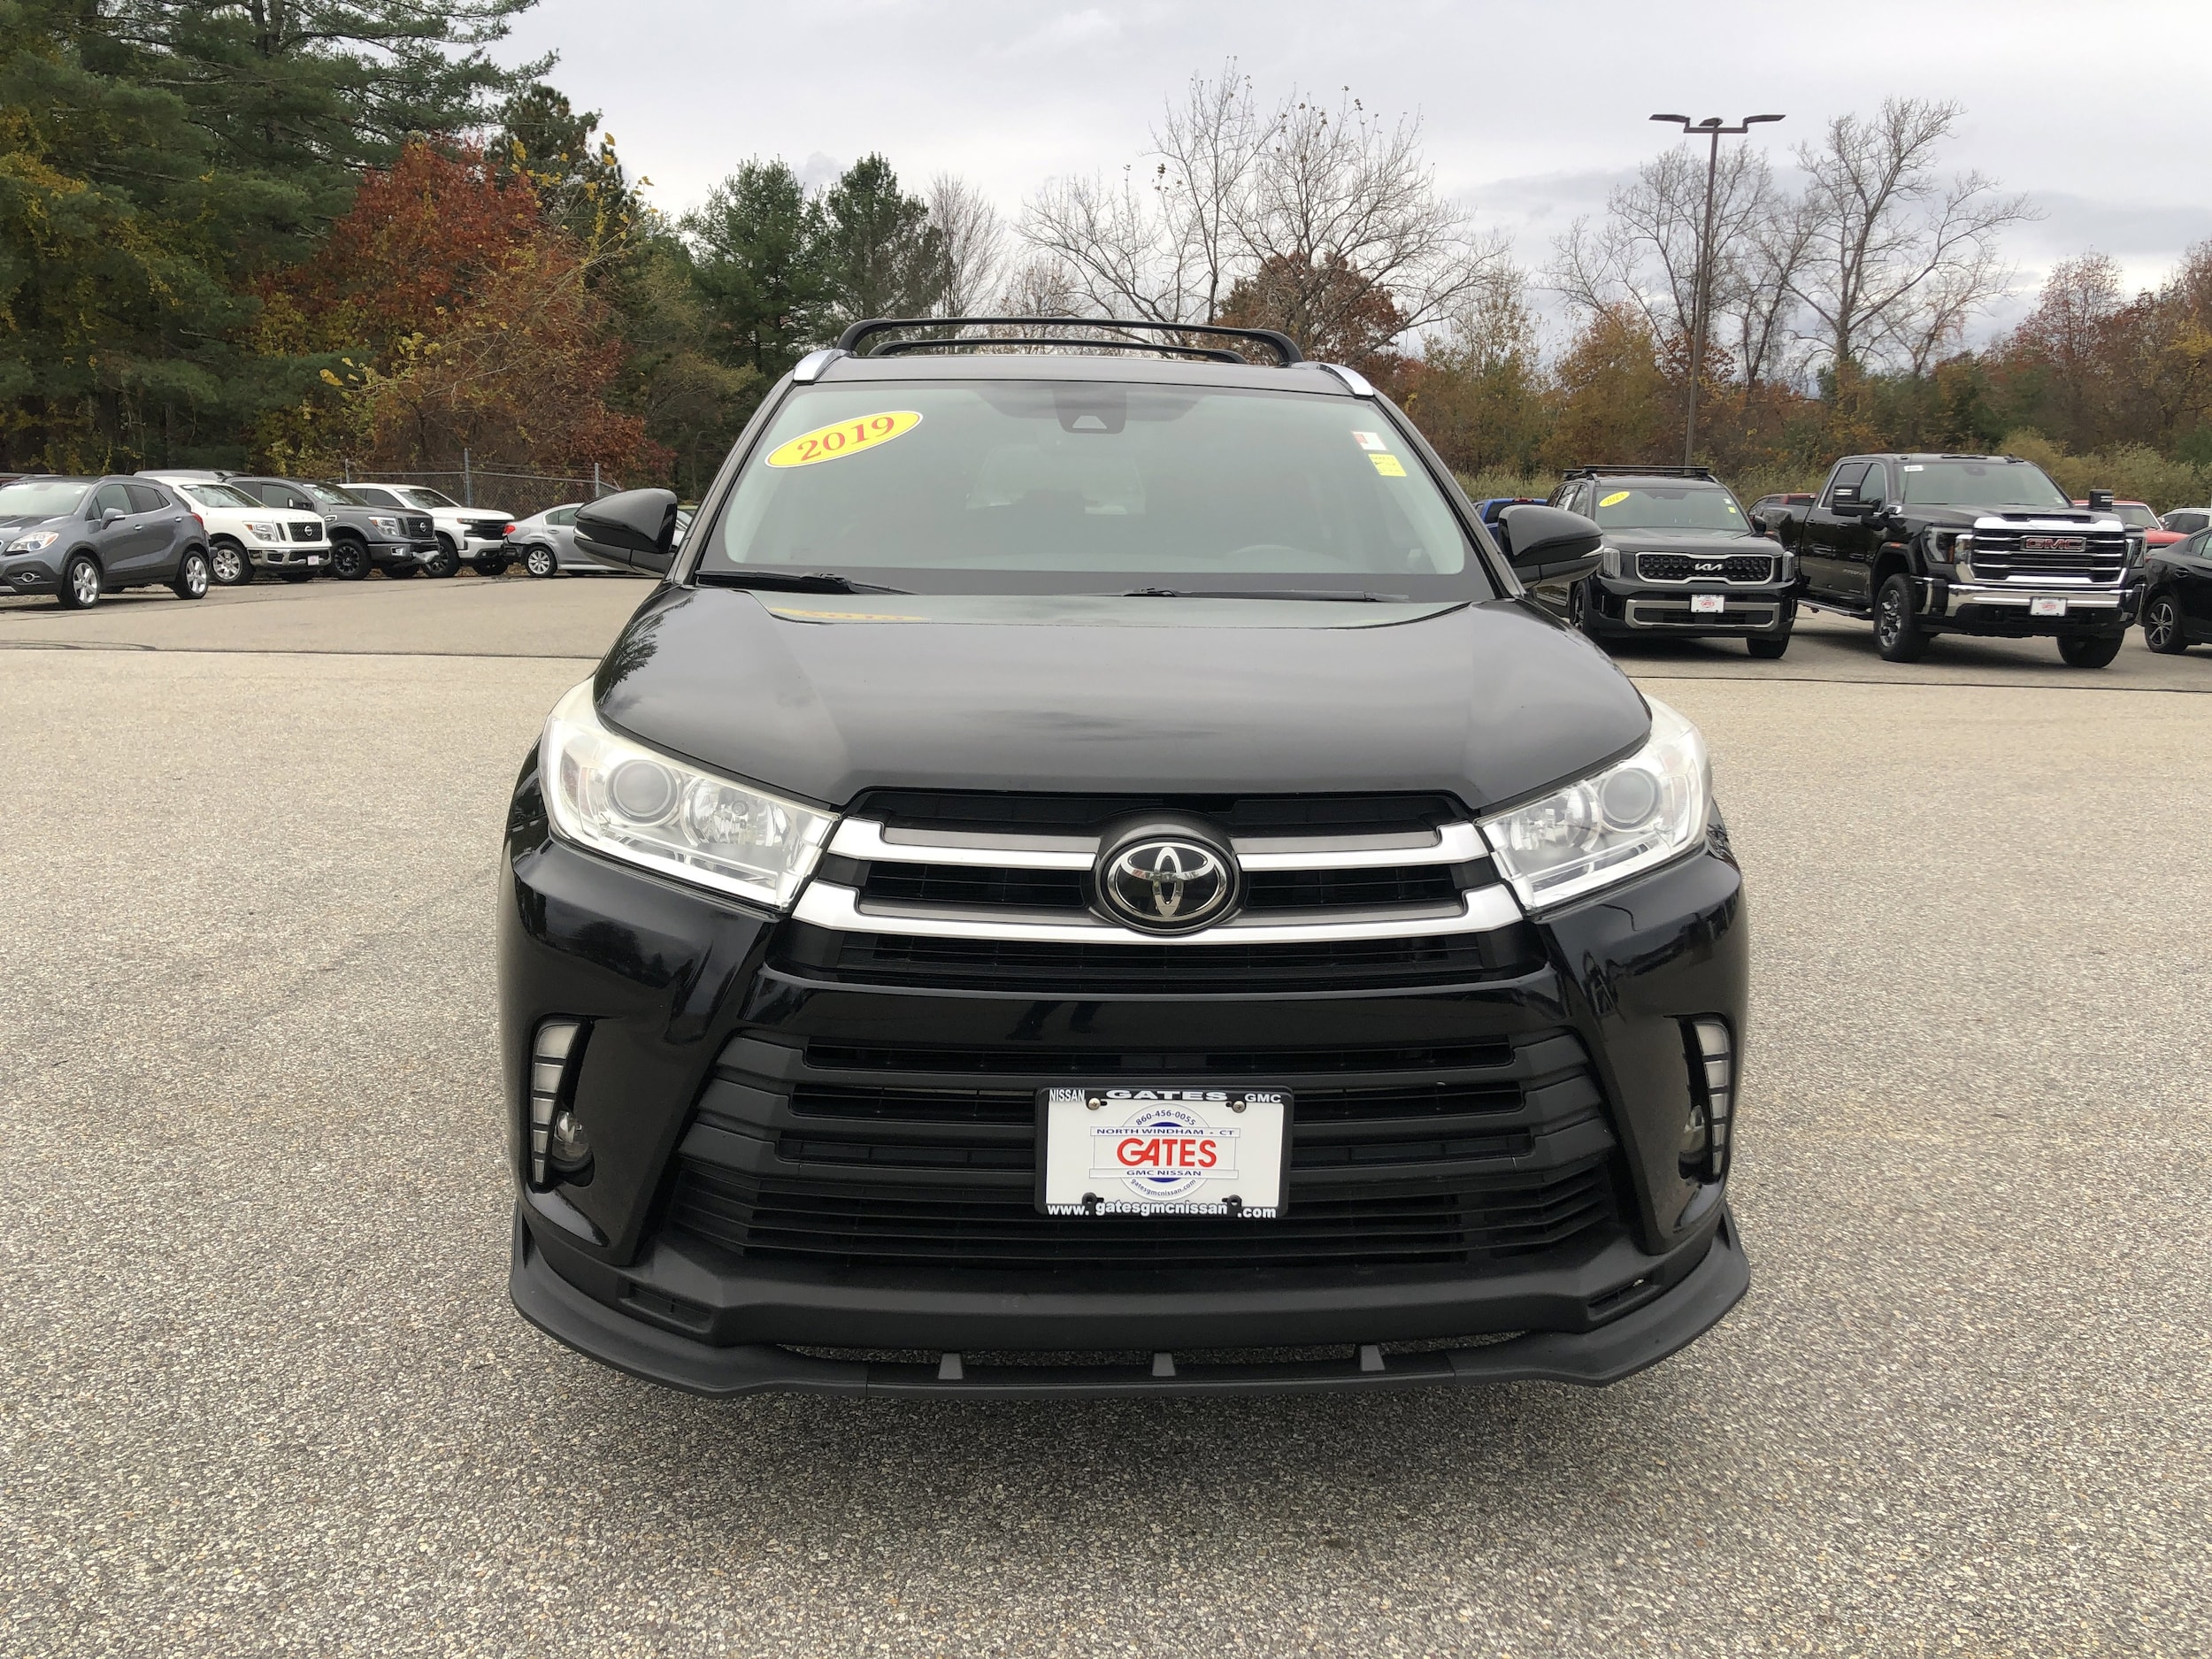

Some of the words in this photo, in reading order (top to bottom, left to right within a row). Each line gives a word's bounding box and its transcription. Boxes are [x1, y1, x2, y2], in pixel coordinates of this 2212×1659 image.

[796, 416, 895, 462] 2019
[2025, 538, 2083, 549] GMC
[1048, 1088, 1086, 1102] NISSAN
[1106, 1089, 1228, 1101] GATES
[1244, 1093, 1282, 1103] GMC
[1135, 1110, 1196, 1126] 860-456-0055
[1117, 1137, 1217, 1168] GATES
[1130, 1178, 1197, 1197] gatesgmcnissan.com
[1048, 1204, 1089, 1216] www.
[1095, 1201, 1228, 1217] gatesgmcnissan
[1237, 1207, 1277, 1218] .com
